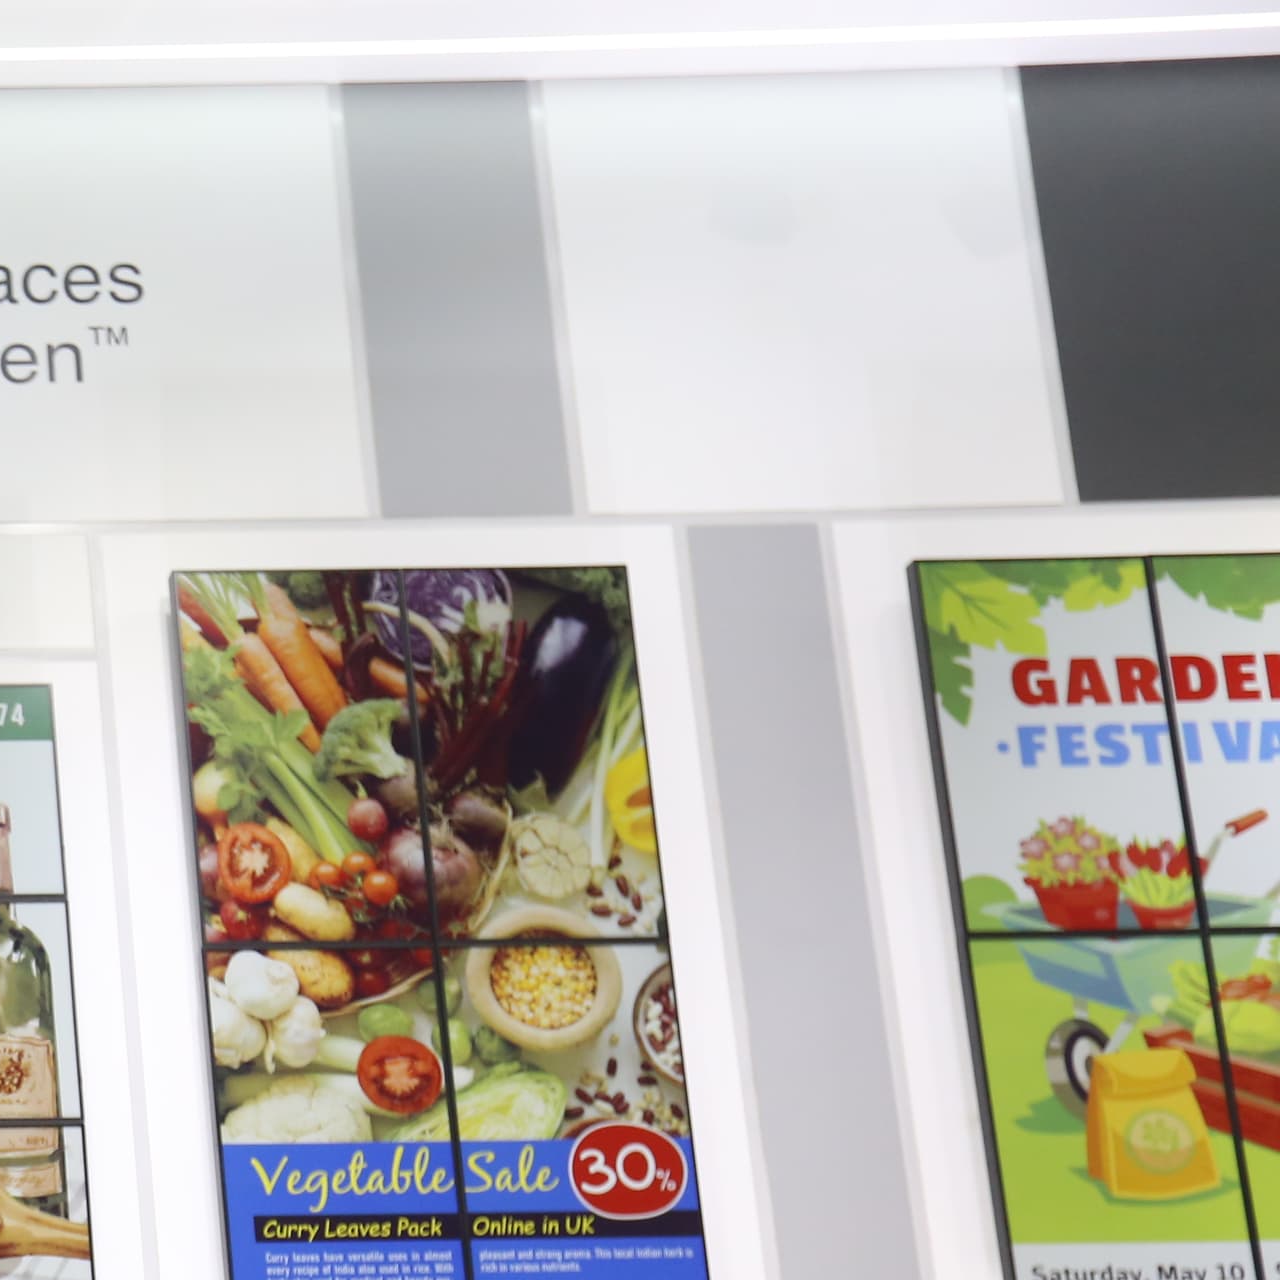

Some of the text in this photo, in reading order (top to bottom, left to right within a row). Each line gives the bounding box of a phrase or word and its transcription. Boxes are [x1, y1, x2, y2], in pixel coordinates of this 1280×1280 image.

[251, 1146, 455, 1213] Vegetable
[465, 1145, 559, 1194] Sale
[263, 1217, 442, 1241] Curry Leaves Pack
[473, 1216, 594, 1237] Online in UK
